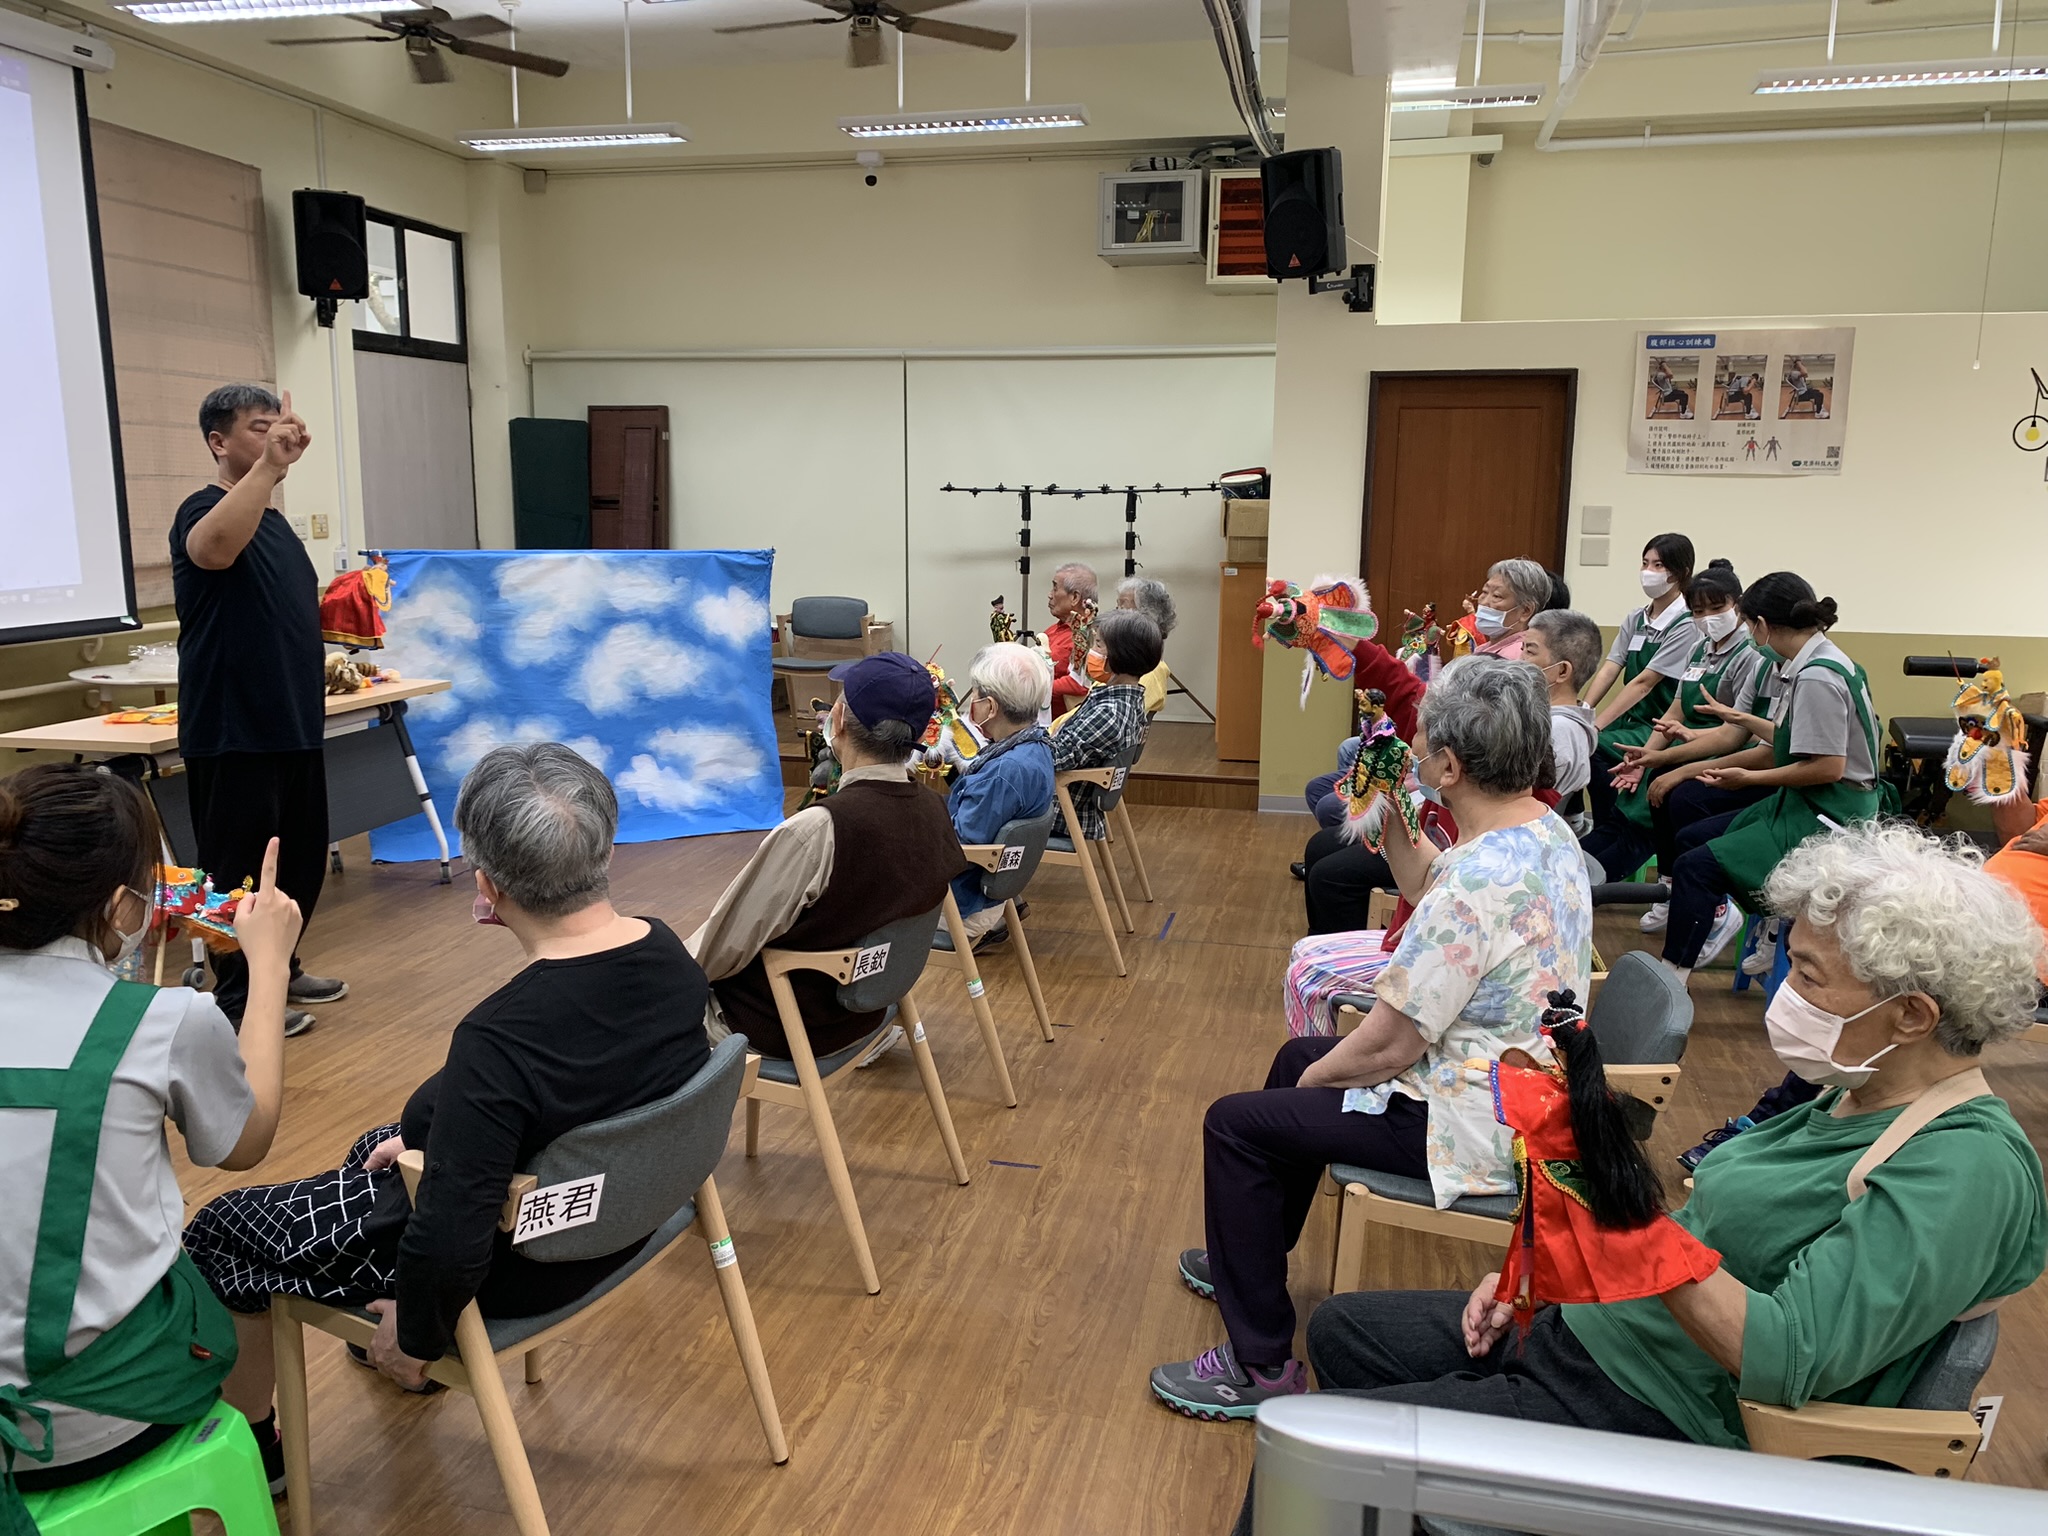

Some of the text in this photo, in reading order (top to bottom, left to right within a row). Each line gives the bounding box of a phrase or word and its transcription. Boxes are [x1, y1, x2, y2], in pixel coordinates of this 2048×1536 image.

[1650, 337, 1712, 347] 腹部核心訓練機
[854, 948, 888, 979] 長欽
[518, 1182, 598, 1236] 燕君
